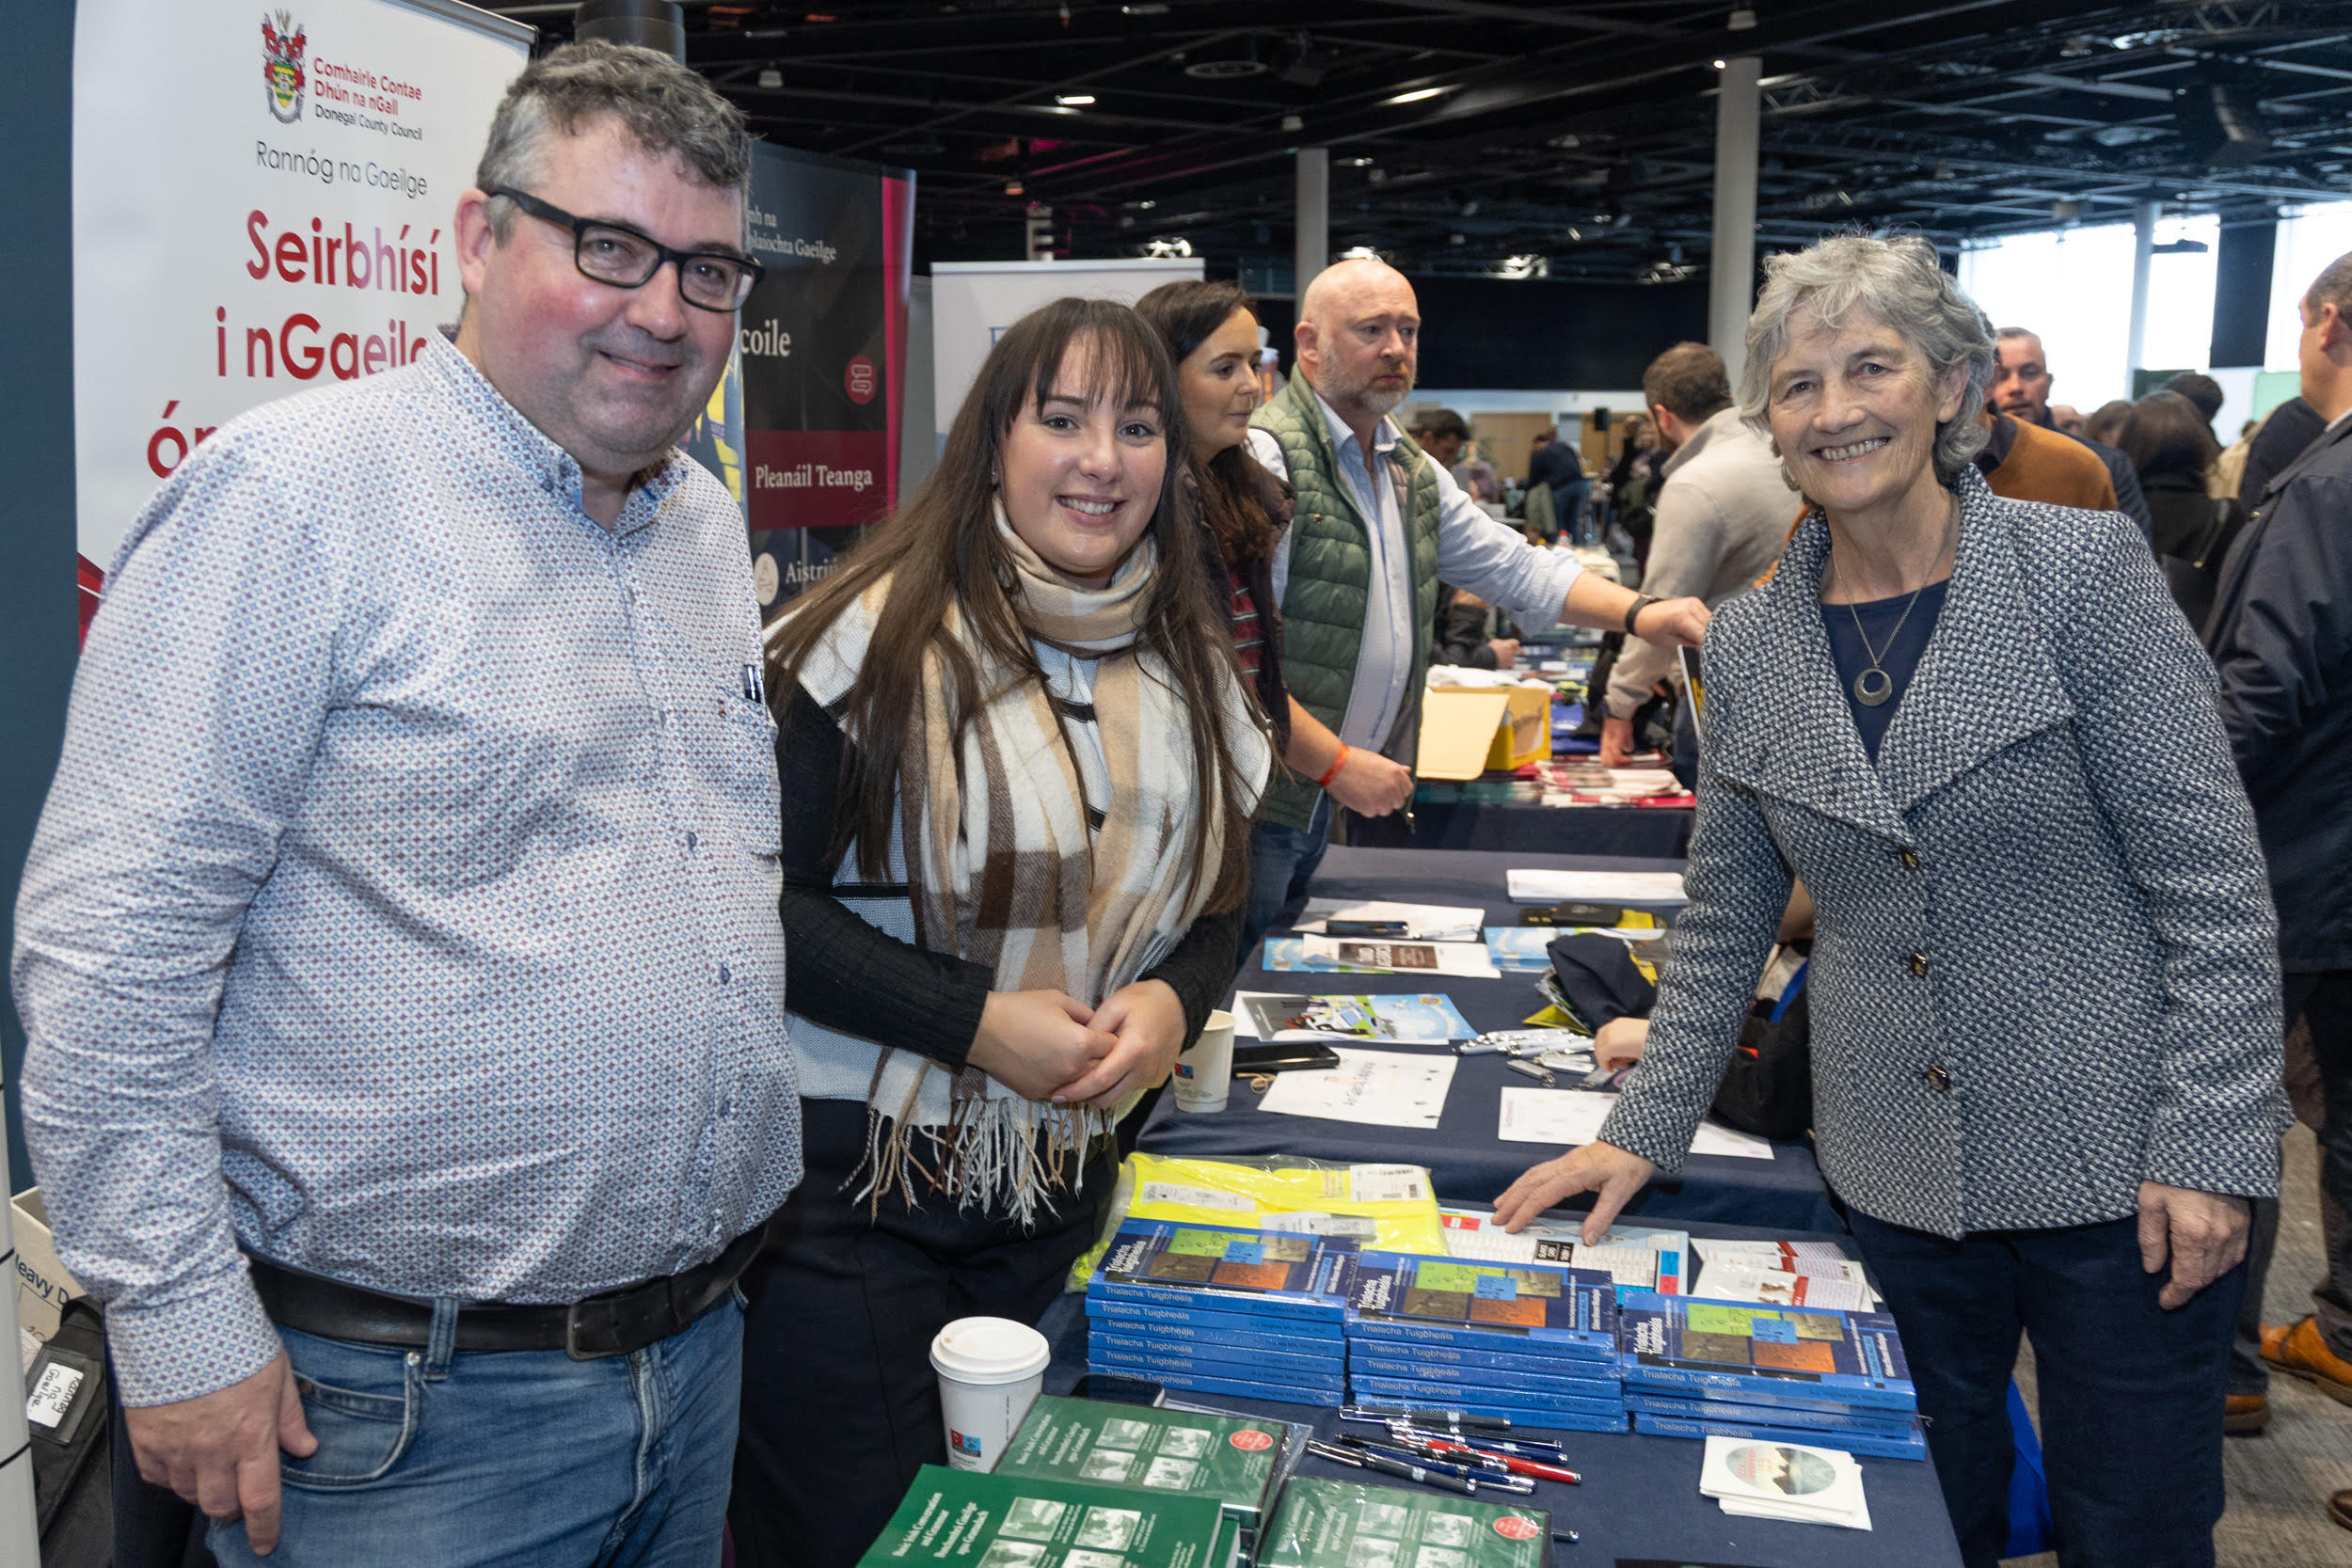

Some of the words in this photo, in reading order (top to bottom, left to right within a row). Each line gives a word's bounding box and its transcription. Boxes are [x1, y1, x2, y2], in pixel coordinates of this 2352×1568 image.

[314, 57, 376, 88] Comhairle
[381, 76, 422, 101] Contae
[315, 80, 350, 103] Dhún
[353, 95, 366, 106] na
[370, 98, 398, 115] nGall
[315, 104, 357, 126] Donegal
[359, 116, 389, 135] County
[391, 122, 422, 140] Council
[257, 140, 333, 183] Rannóg
[340, 161, 361, 183] na
[366, 161, 427, 198] Gaeilge
[246, 210, 441, 296] Seirbhísí
[795, 239, 837, 265] Gaeilge
[216, 306, 227, 377] i
[740, 318, 791, 357] coile
[755, 463, 813, 489] Pleanáil
[816, 465, 874, 493] Teanga
[15, 1254, 54, 1298] eavy
[1105, 1286, 1144, 1297] Trialacha
[1102, 1304, 1140, 1315] Trialacha
[1107, 1319, 1145, 1331] Trialacha
[1361, 1323, 1402, 1336] Trialacha
[1105, 1336, 1144, 1348] Trialacha
[1368, 1343, 1408, 1355] Trialacha
[1105, 1351, 1144, 1363] Trialacha
[1367, 1360, 1407, 1372] Trialacha
[1642, 1369, 1686, 1382] Trialacha
[1369, 1380, 1409, 1391] Trialacha
[1643, 1399, 1687, 1411] Trialacha
[1654, 1421, 1698, 1433] Trialacha
[903, 1529, 921, 1544] Irish
